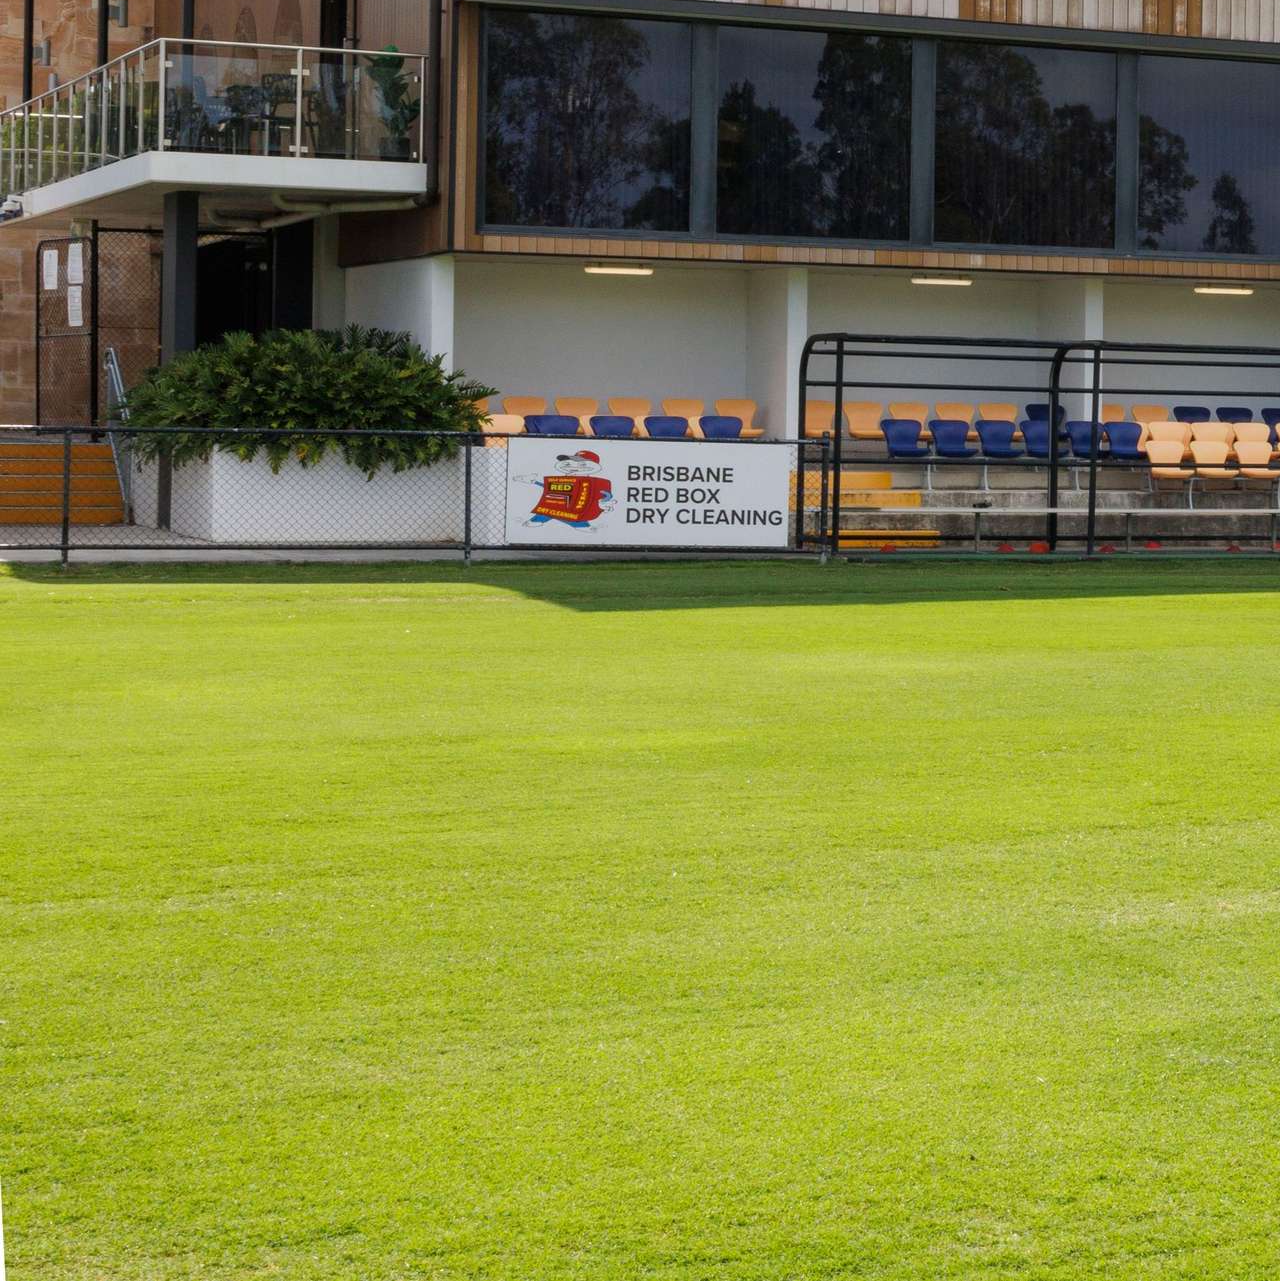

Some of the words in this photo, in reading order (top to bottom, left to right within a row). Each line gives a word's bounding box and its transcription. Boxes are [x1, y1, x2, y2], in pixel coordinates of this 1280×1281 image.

[628, 465, 734, 483] BRISBANE
[550, 483, 572, 491] RED
[627, 487, 669, 503] RED
[676, 488, 720, 504] BOX
[626, 508, 670, 524] DRY
[676, 509, 783, 526] CLEANING
